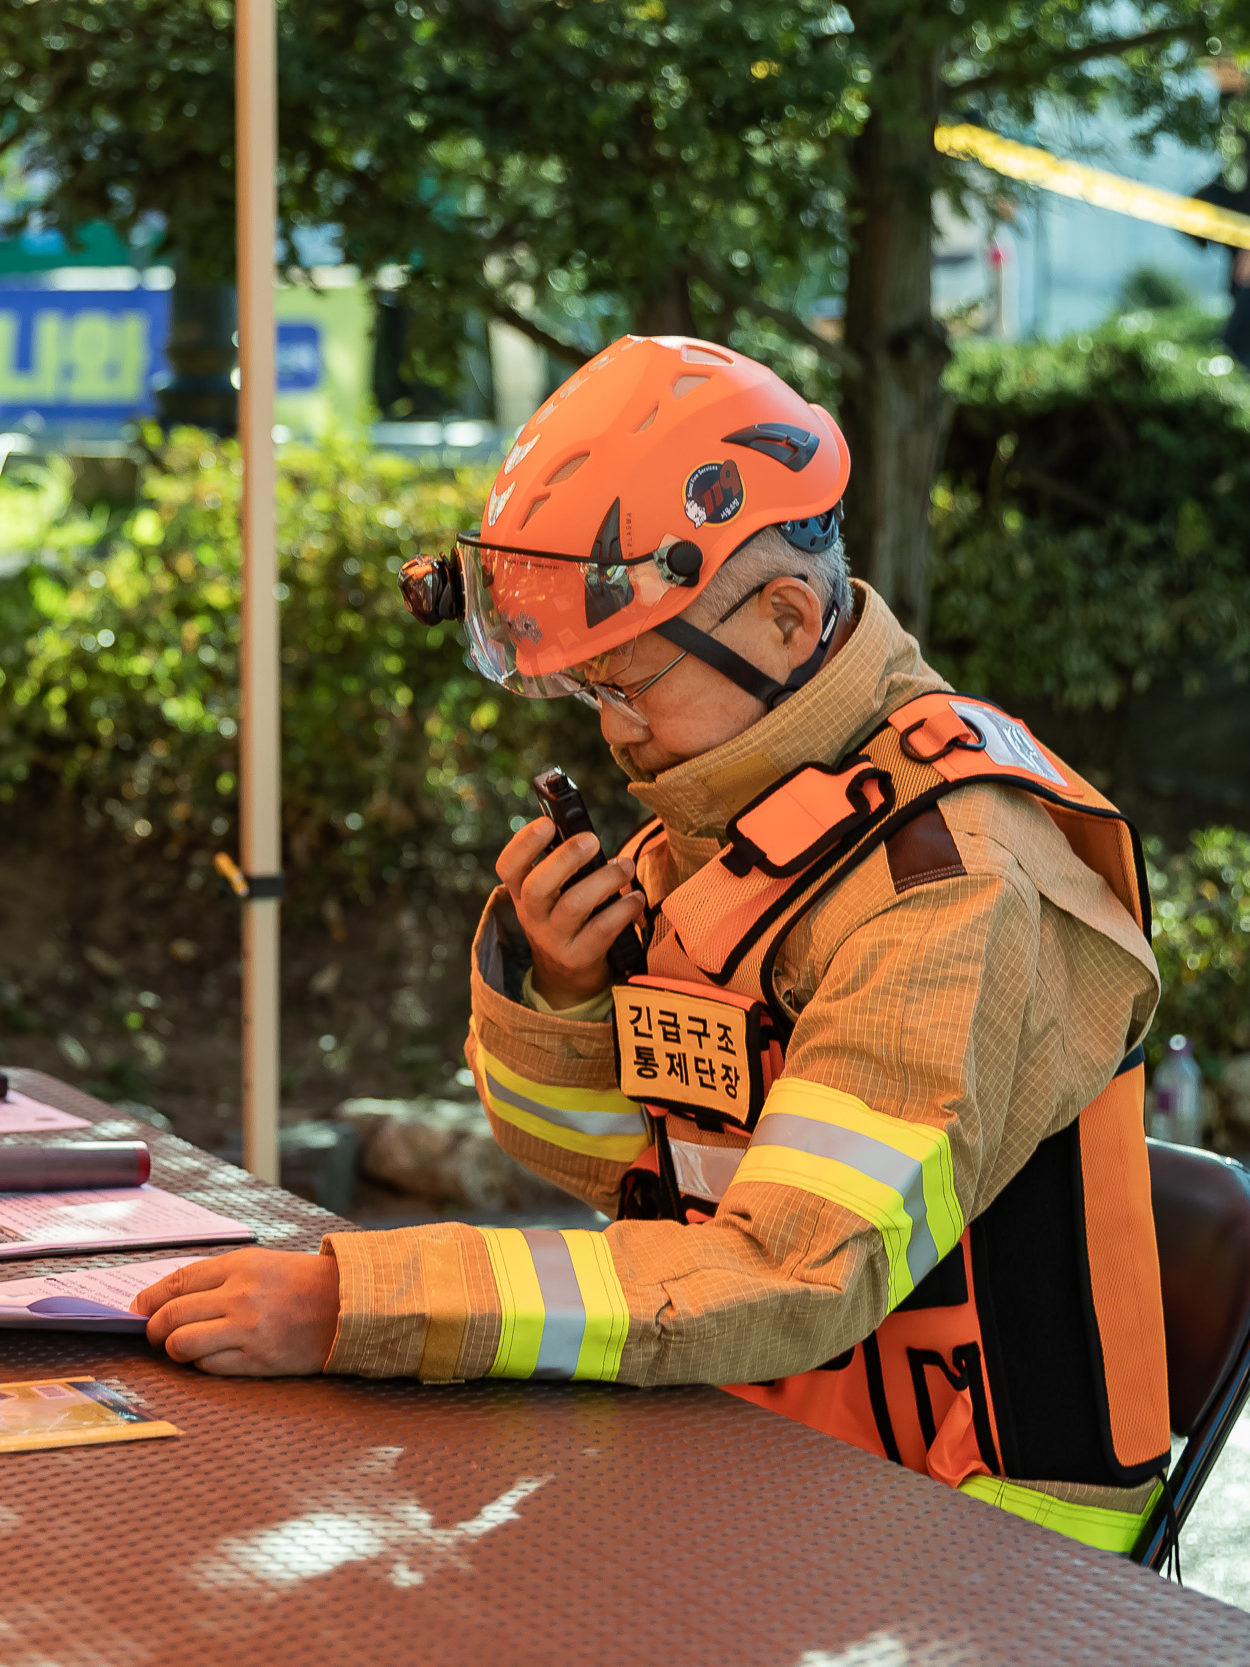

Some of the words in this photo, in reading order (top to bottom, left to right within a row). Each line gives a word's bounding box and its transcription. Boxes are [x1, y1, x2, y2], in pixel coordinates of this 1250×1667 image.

[702, 460, 741, 517] 119
[628, 1004, 737, 1056] 긴급구조
[633, 1045, 740, 1100] 통제단장
